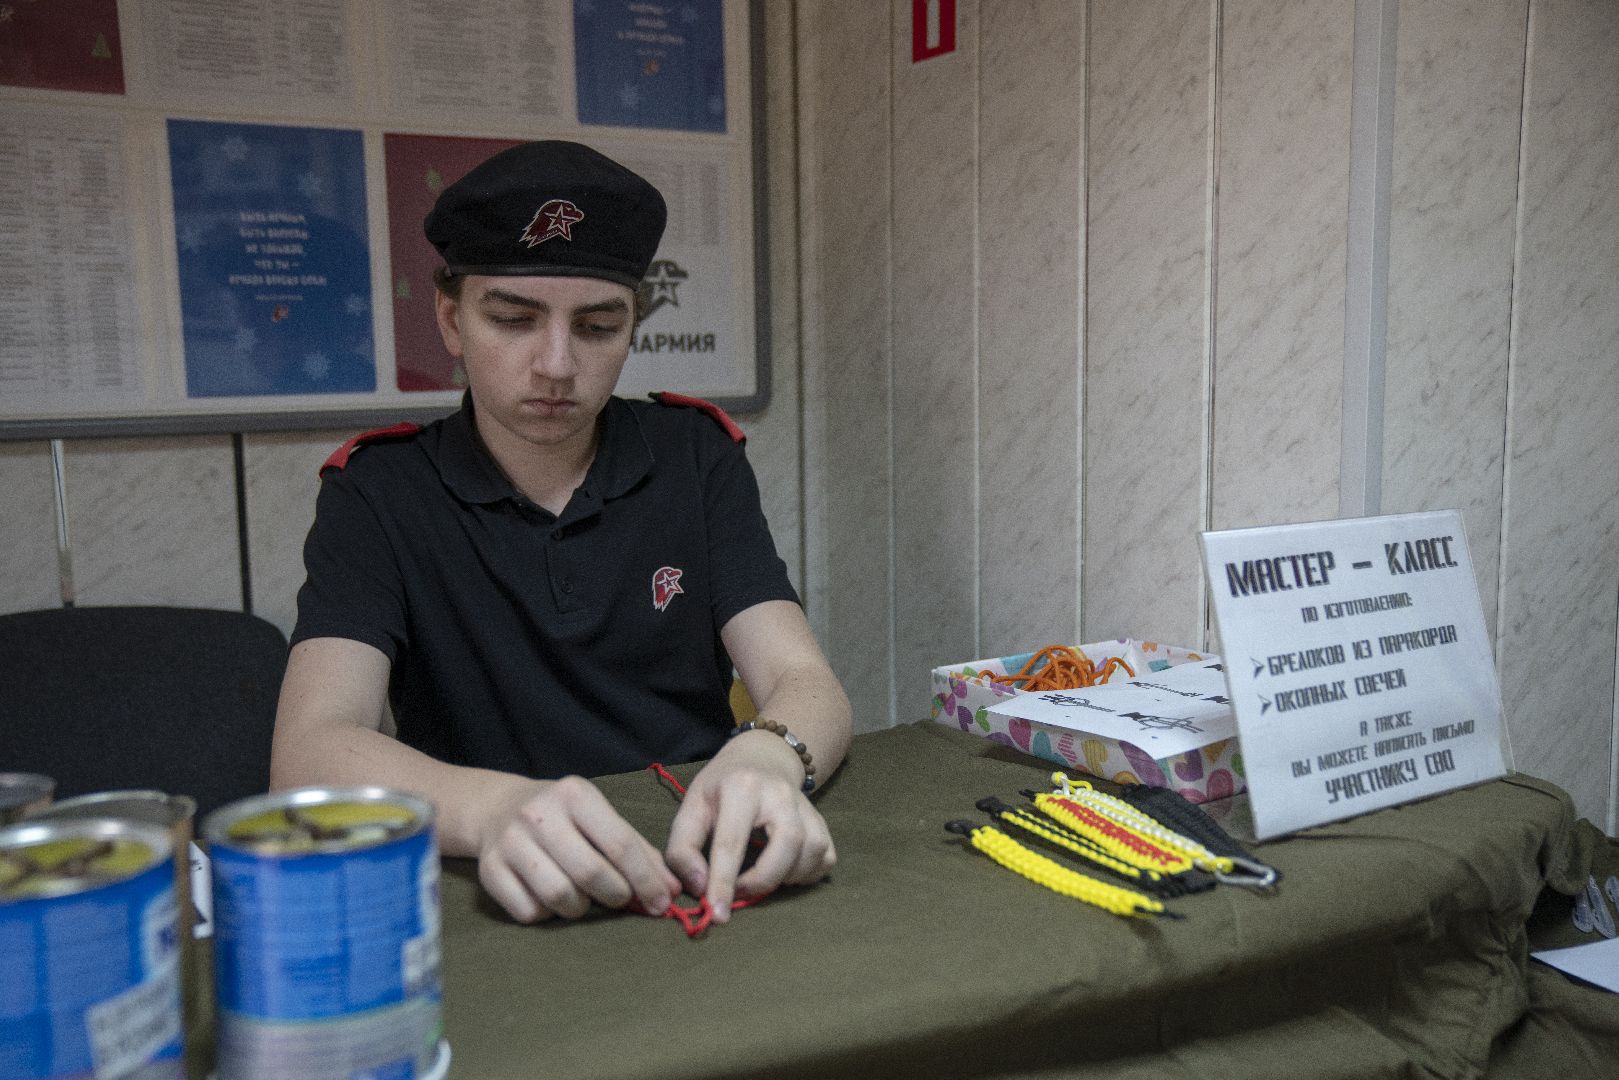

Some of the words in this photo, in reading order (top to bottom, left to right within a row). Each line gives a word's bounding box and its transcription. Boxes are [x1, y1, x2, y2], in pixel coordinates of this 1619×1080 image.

[1225, 551, 1336, 598] МАСТЕР
[1384, 536, 1458, 575] КЛАСС
[1301, 606, 1319, 623] ПО
[1267, 644, 1346, 676] БРЕЛОКОВ
[1352, 639, 1373, 660] ИЗ
[1378, 624, 1458, 656] ПАРАКОРДА
[1274, 680, 1348, 713] ОКОПНЫХ
[1354, 668, 1407, 696] СВЕЧЕЙ
[1291, 758, 1312, 778] ВЫ
[1317, 745, 1369, 771] МОЖЕТЕ
[1374, 731, 1427, 758] НАПИСАТЬ
[1432, 719, 1475, 744] ПИСЬМО
[1359, 721, 1368, 737] А
[1374, 710, 1413, 733] ТАКЖЕ
[1325, 758, 1419, 804] УЧАСТНИКУ
[1424, 749, 1456, 777] СВО
